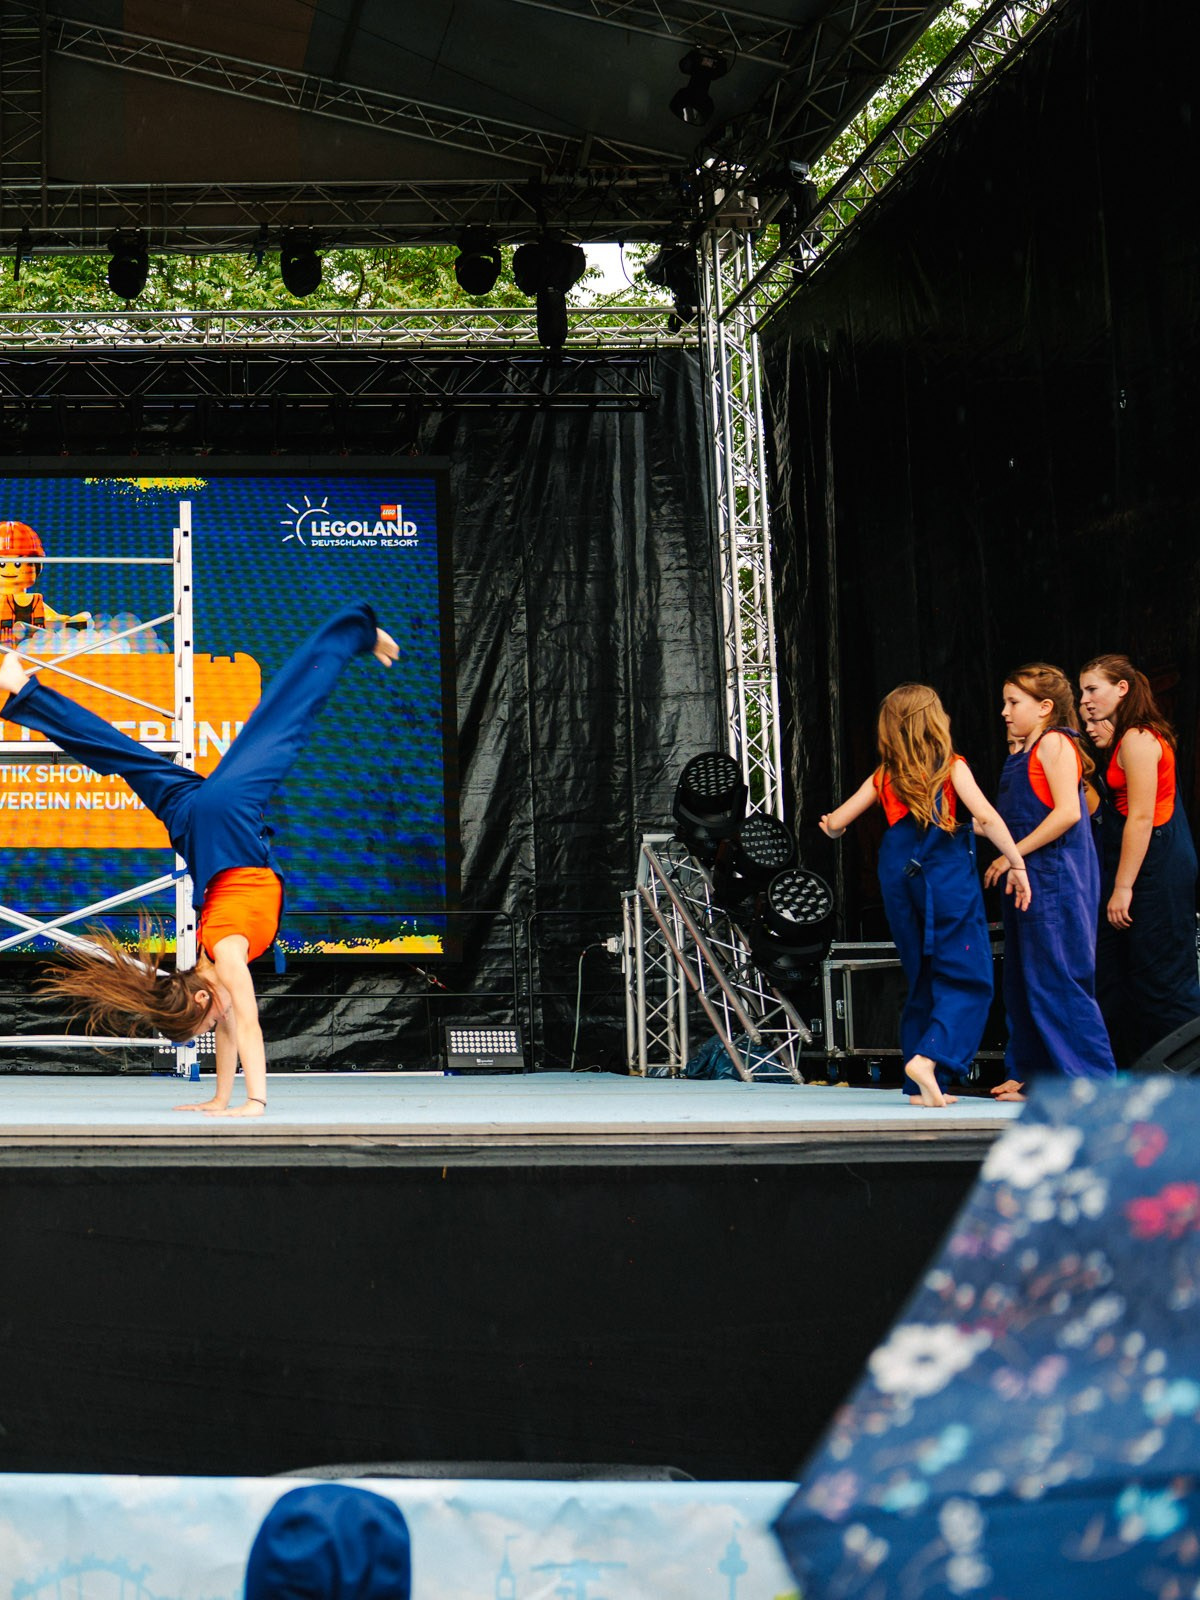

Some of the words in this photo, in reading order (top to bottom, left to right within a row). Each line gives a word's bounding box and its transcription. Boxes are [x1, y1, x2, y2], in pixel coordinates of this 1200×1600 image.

[311, 519, 417, 536] LEGOLAND
[311, 539, 378, 547] DEUTSCHLAND
[380, 539, 419, 547] RESORT
[35, 765, 103, 784] SHOW
[75, 791, 146, 810] NEUM
